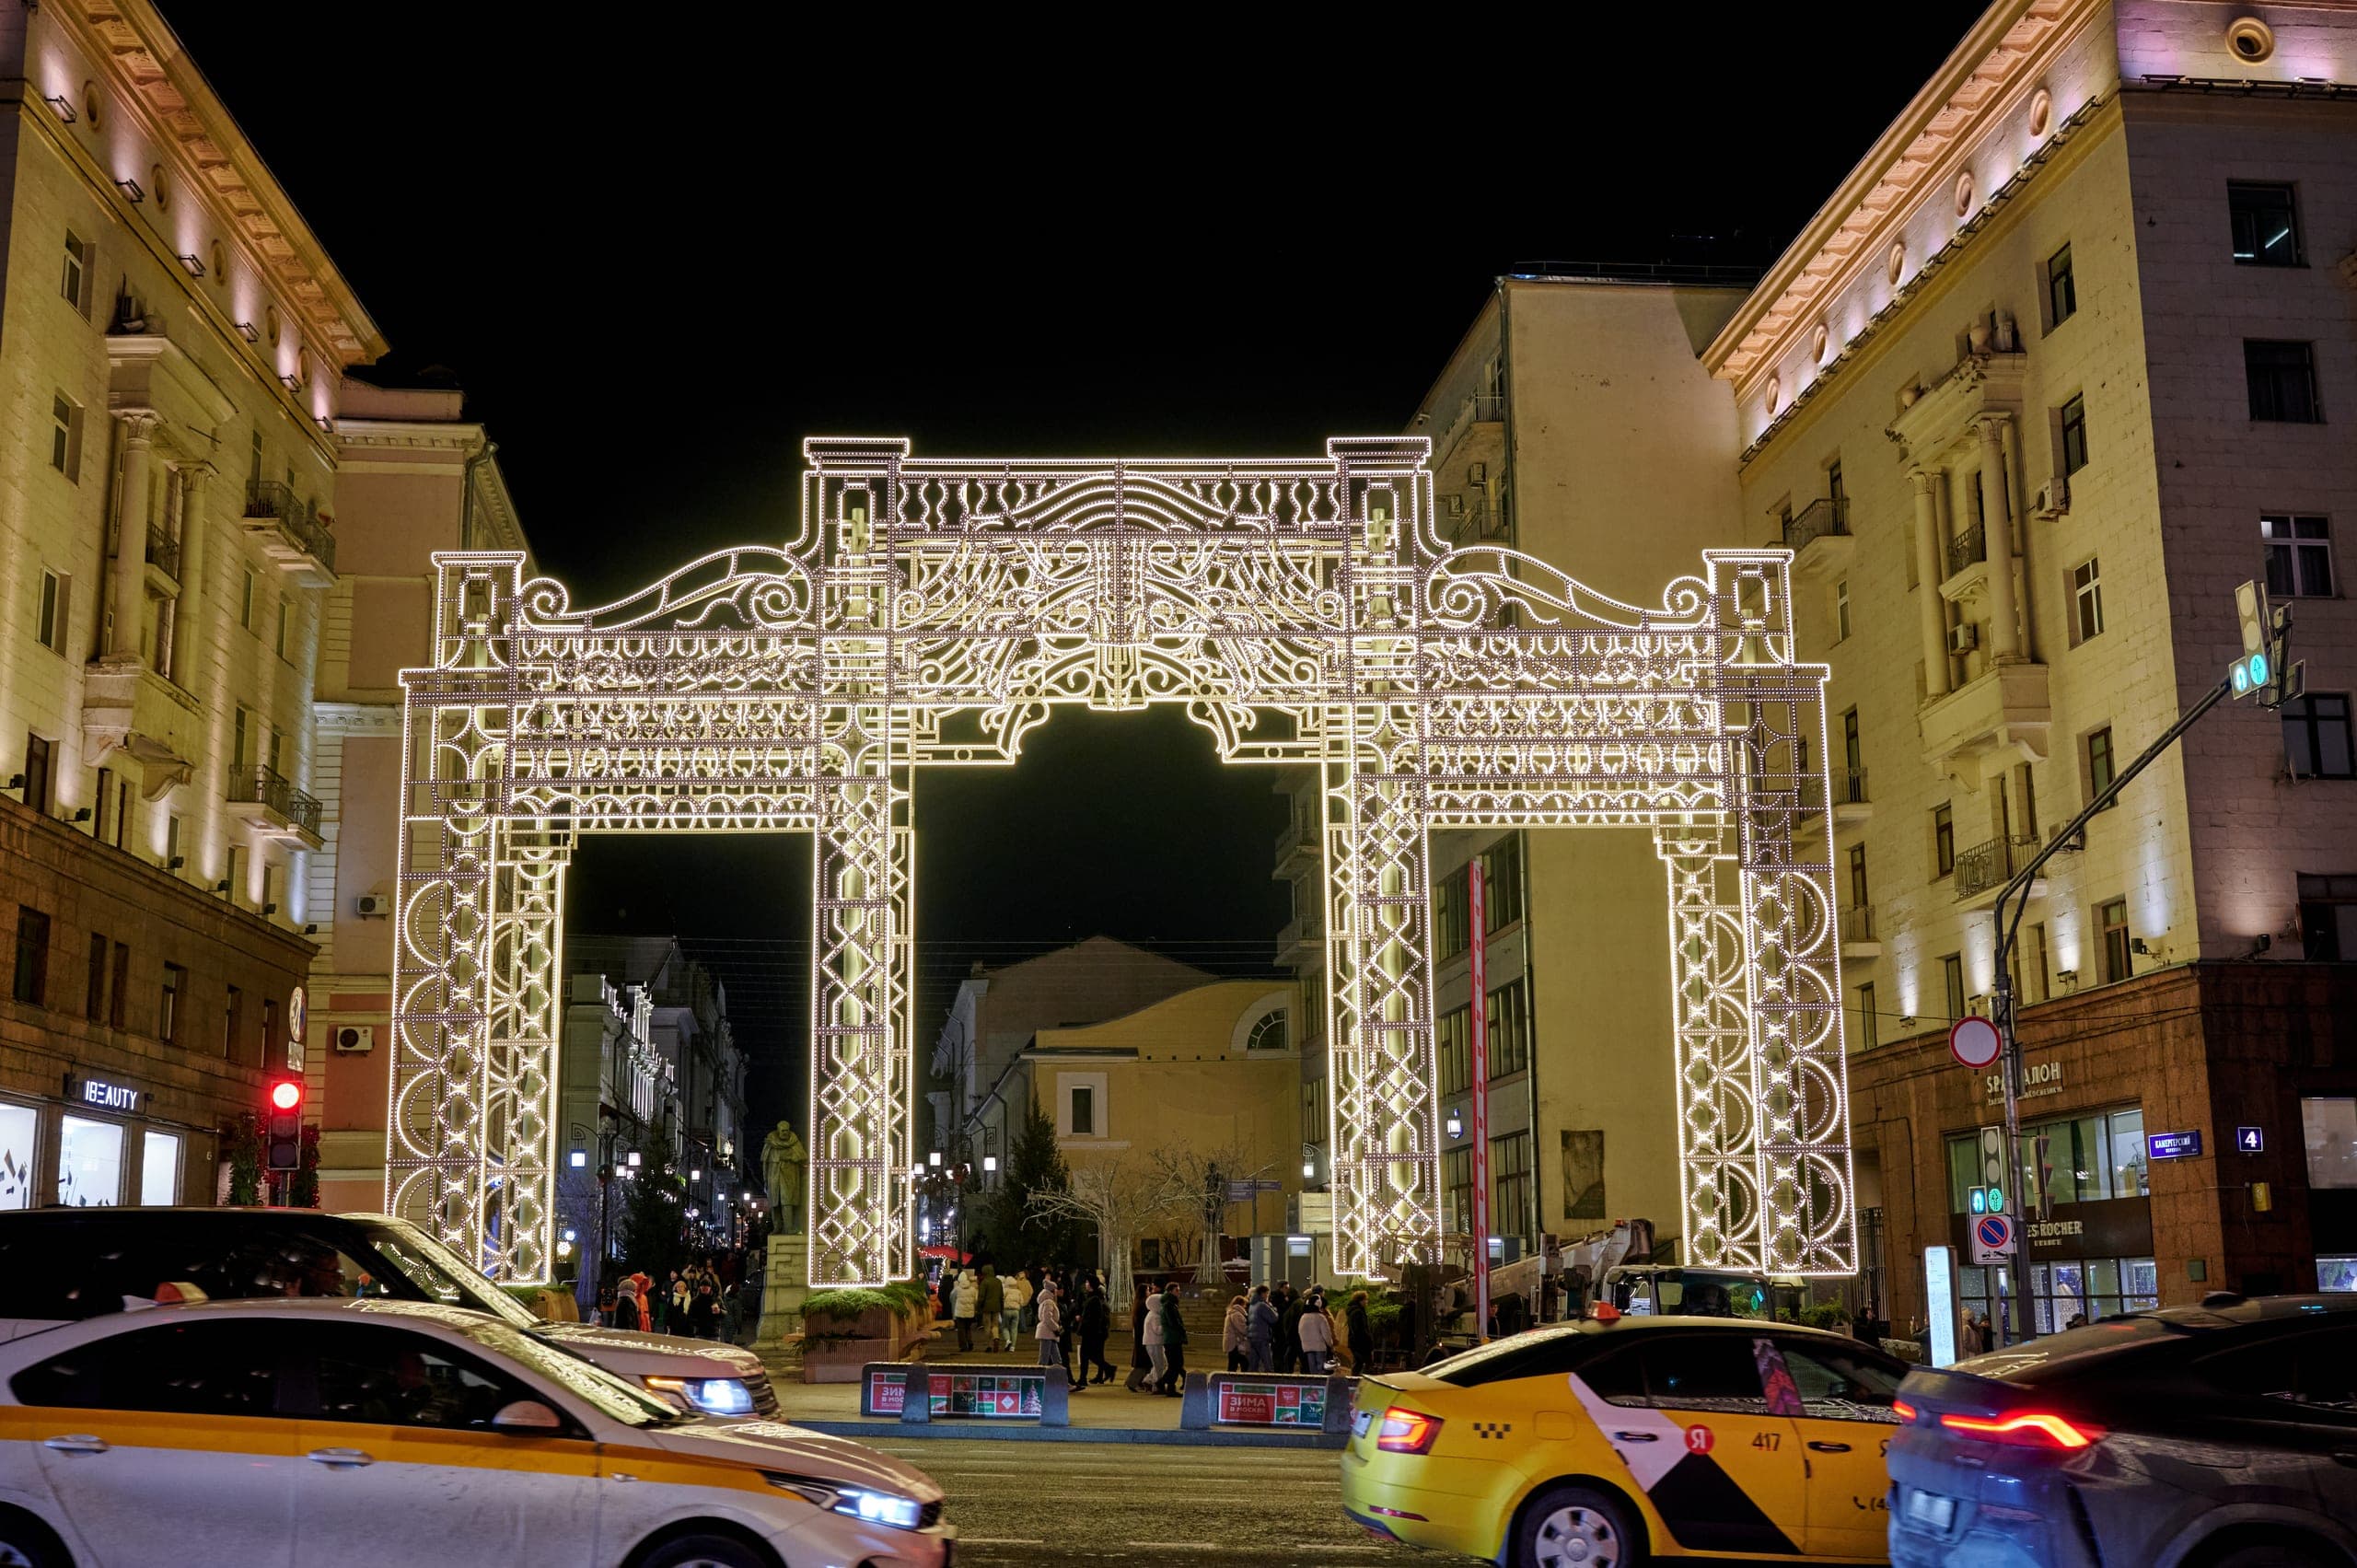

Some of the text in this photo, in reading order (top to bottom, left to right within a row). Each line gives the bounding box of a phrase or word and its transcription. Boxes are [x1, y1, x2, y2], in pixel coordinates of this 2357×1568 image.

[2025, 1062, 2061, 1086] АЛОН
[85, 1080, 138, 1110] IBEAUTY
[2245, 1131, 2258, 1148] 4
[2039, 1220, 2084, 1237] ROCHER
[882, 1387, 905, 1396] ЗИМ
[1229, 1396, 1266, 1408] ЗИМА
[1751, 1431, 1782, 1452] 417
